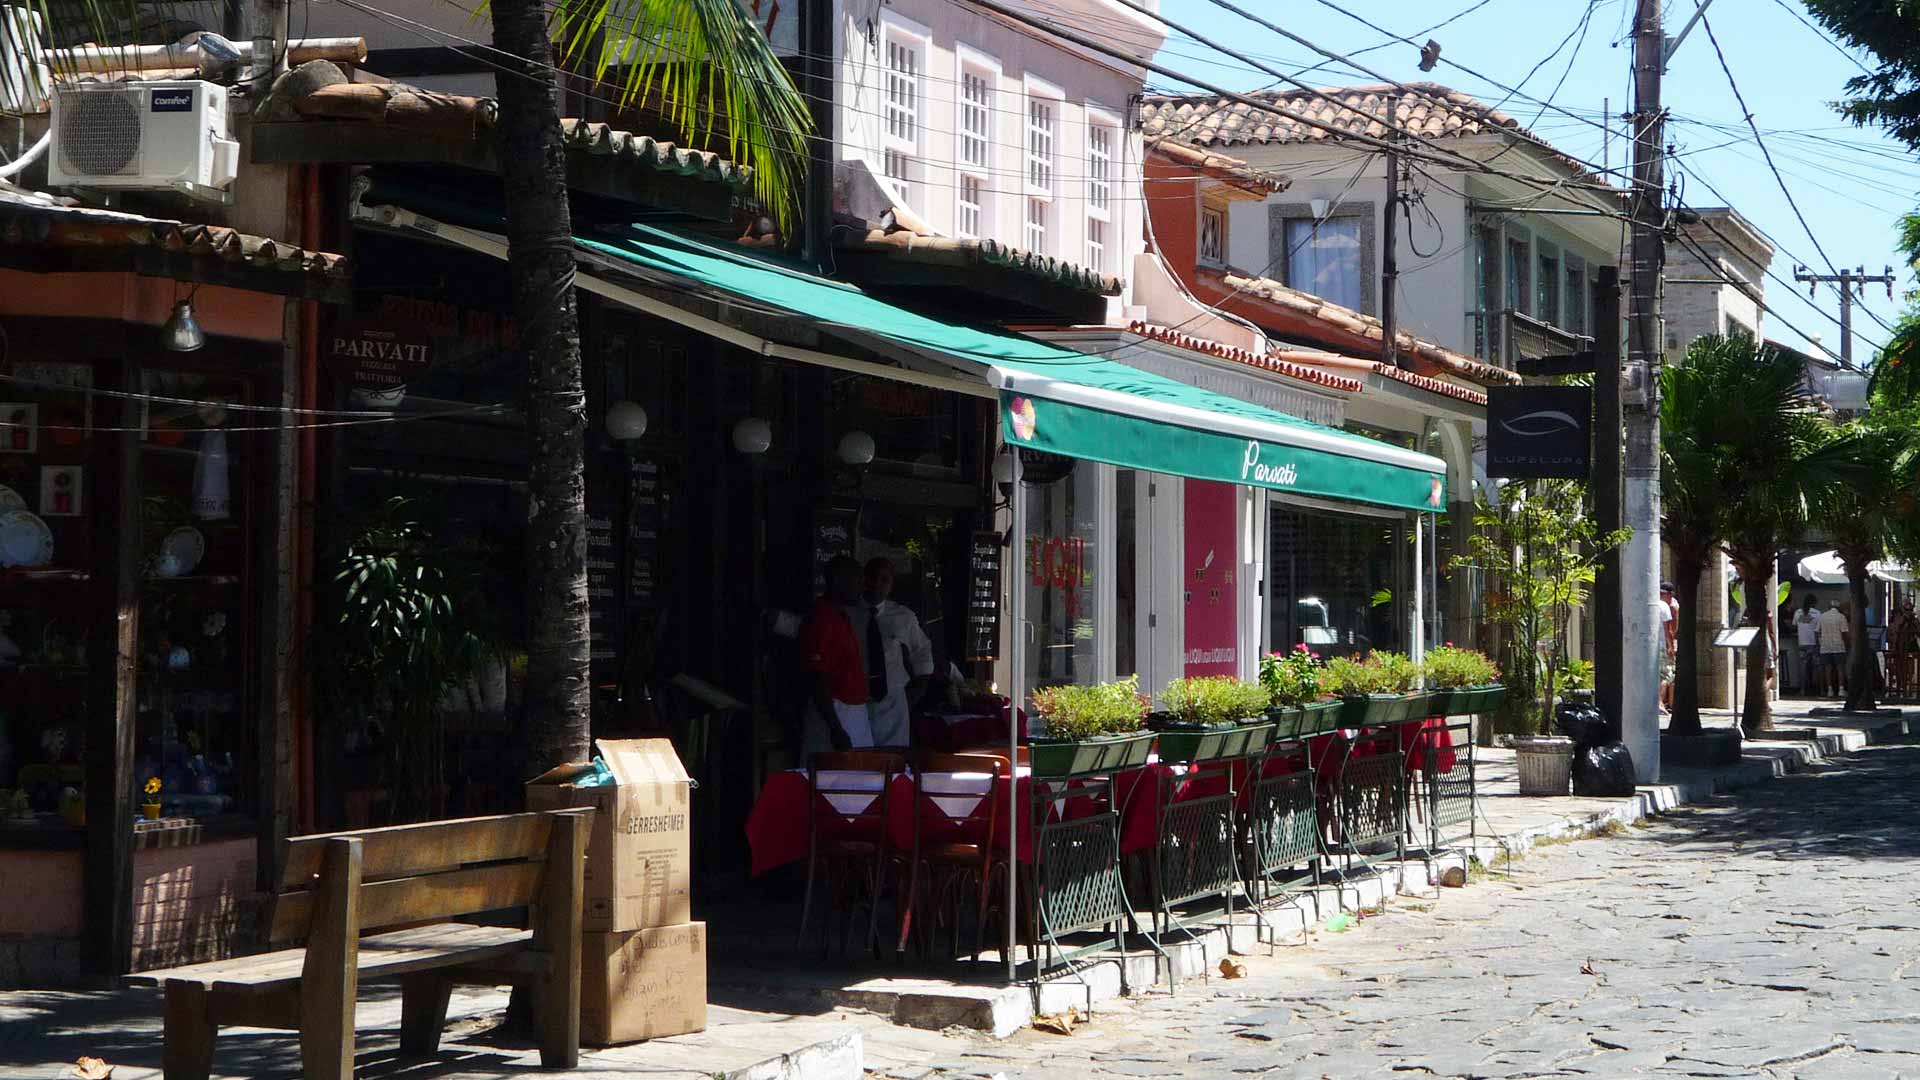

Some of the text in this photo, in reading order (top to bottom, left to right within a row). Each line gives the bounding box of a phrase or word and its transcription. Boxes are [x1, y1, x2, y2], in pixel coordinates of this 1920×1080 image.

[333, 337, 430, 363] PARVATI
[354, 370, 402, 385] TRATTORIA
[1242, 440, 1298, 485] Parvati
[1032, 536, 1084, 587] LIQUI
[626, 808, 685, 834] GERRESHEIMER
